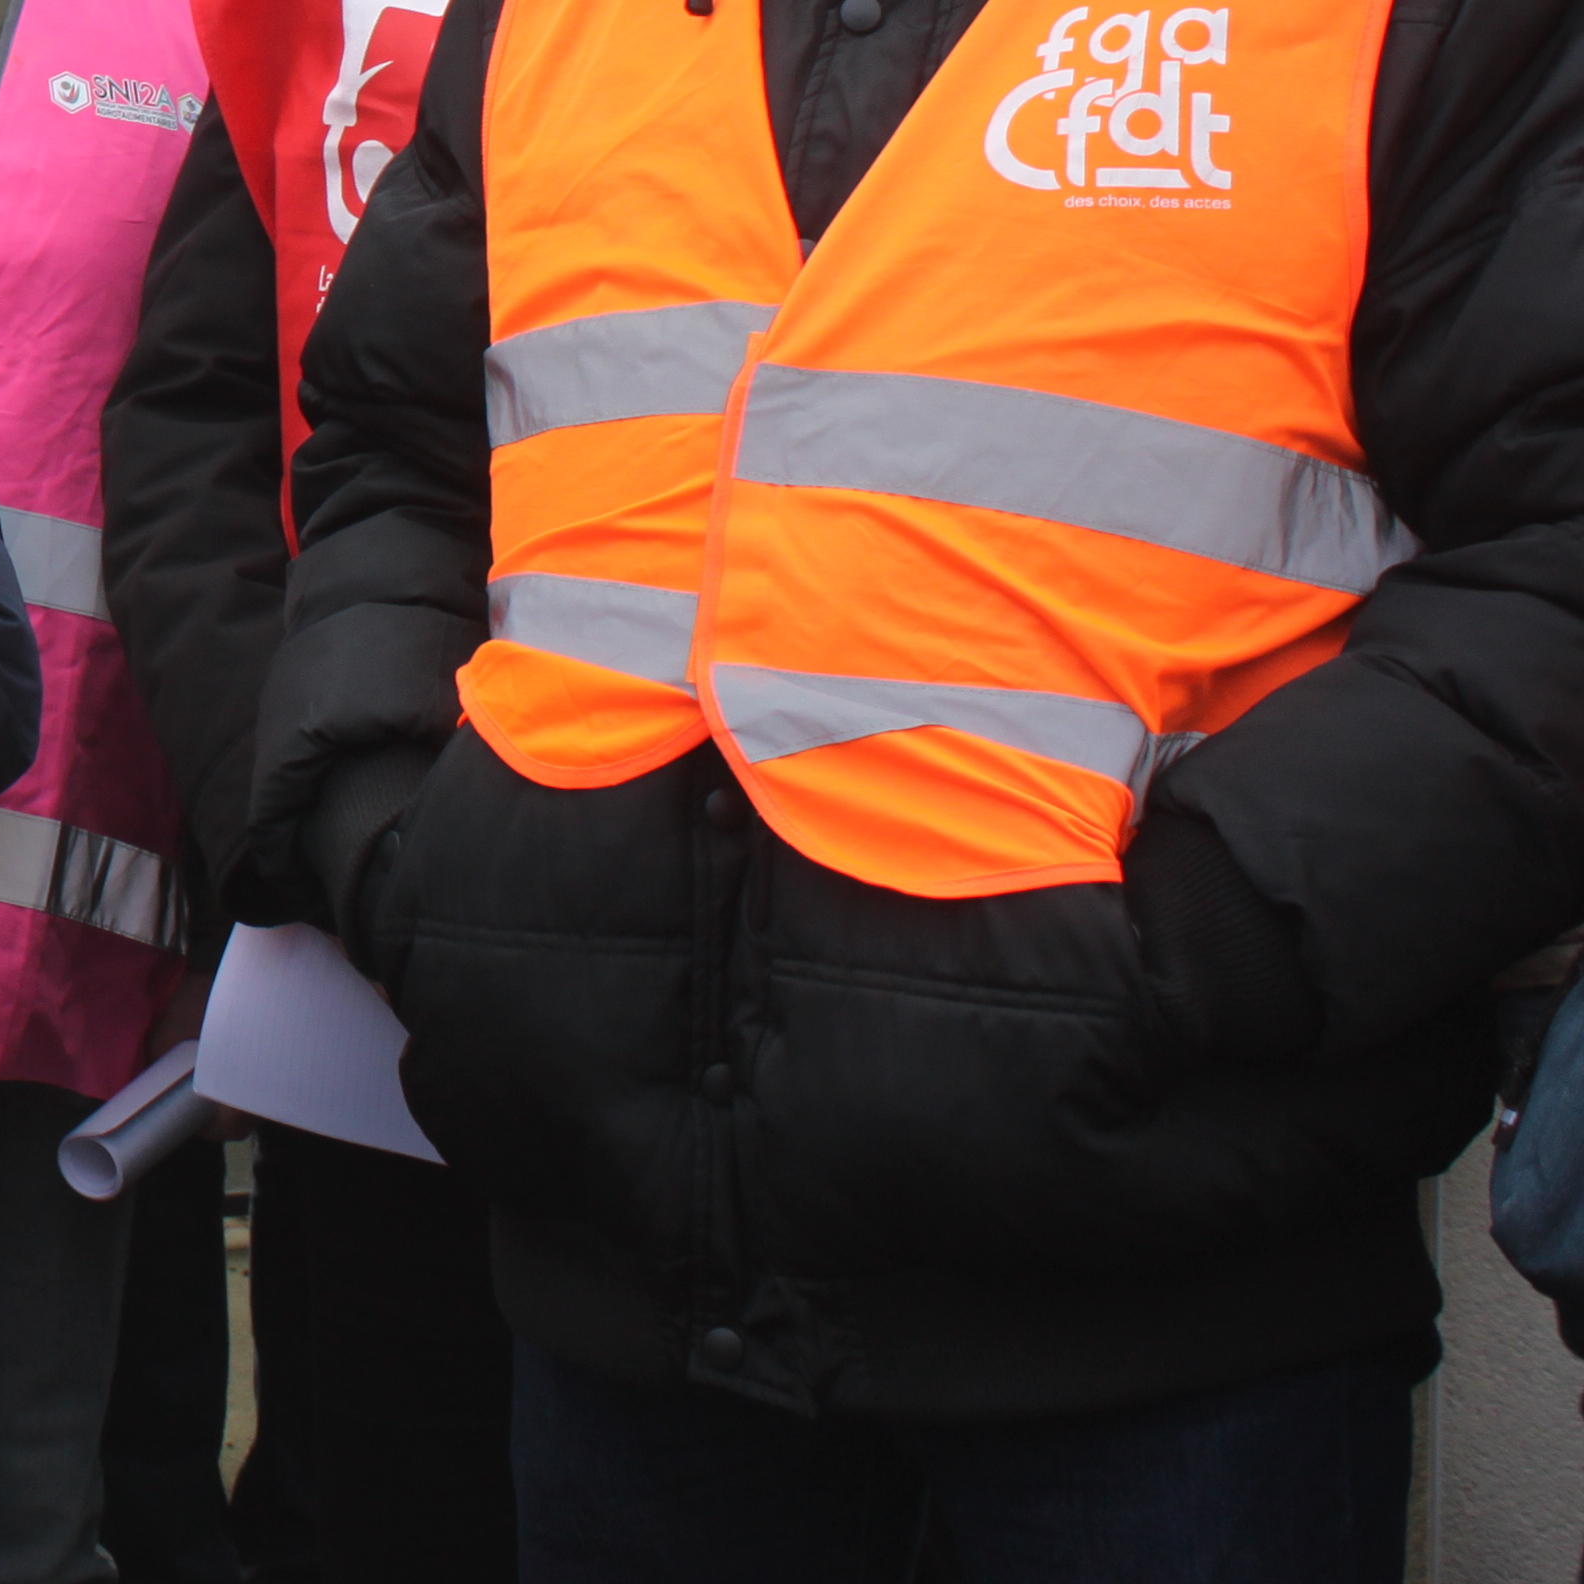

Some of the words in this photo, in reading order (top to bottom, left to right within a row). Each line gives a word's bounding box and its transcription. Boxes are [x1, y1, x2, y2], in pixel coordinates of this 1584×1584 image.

[1035, 6, 1229, 107] fga
[93, 74, 175, 113] SNI2A
[1064, 194, 1094, 208] des
[1098, 194, 1146, 209] choix,
[1149, 195, 1180, 209] des
[1184, 195, 1232, 210] actes
